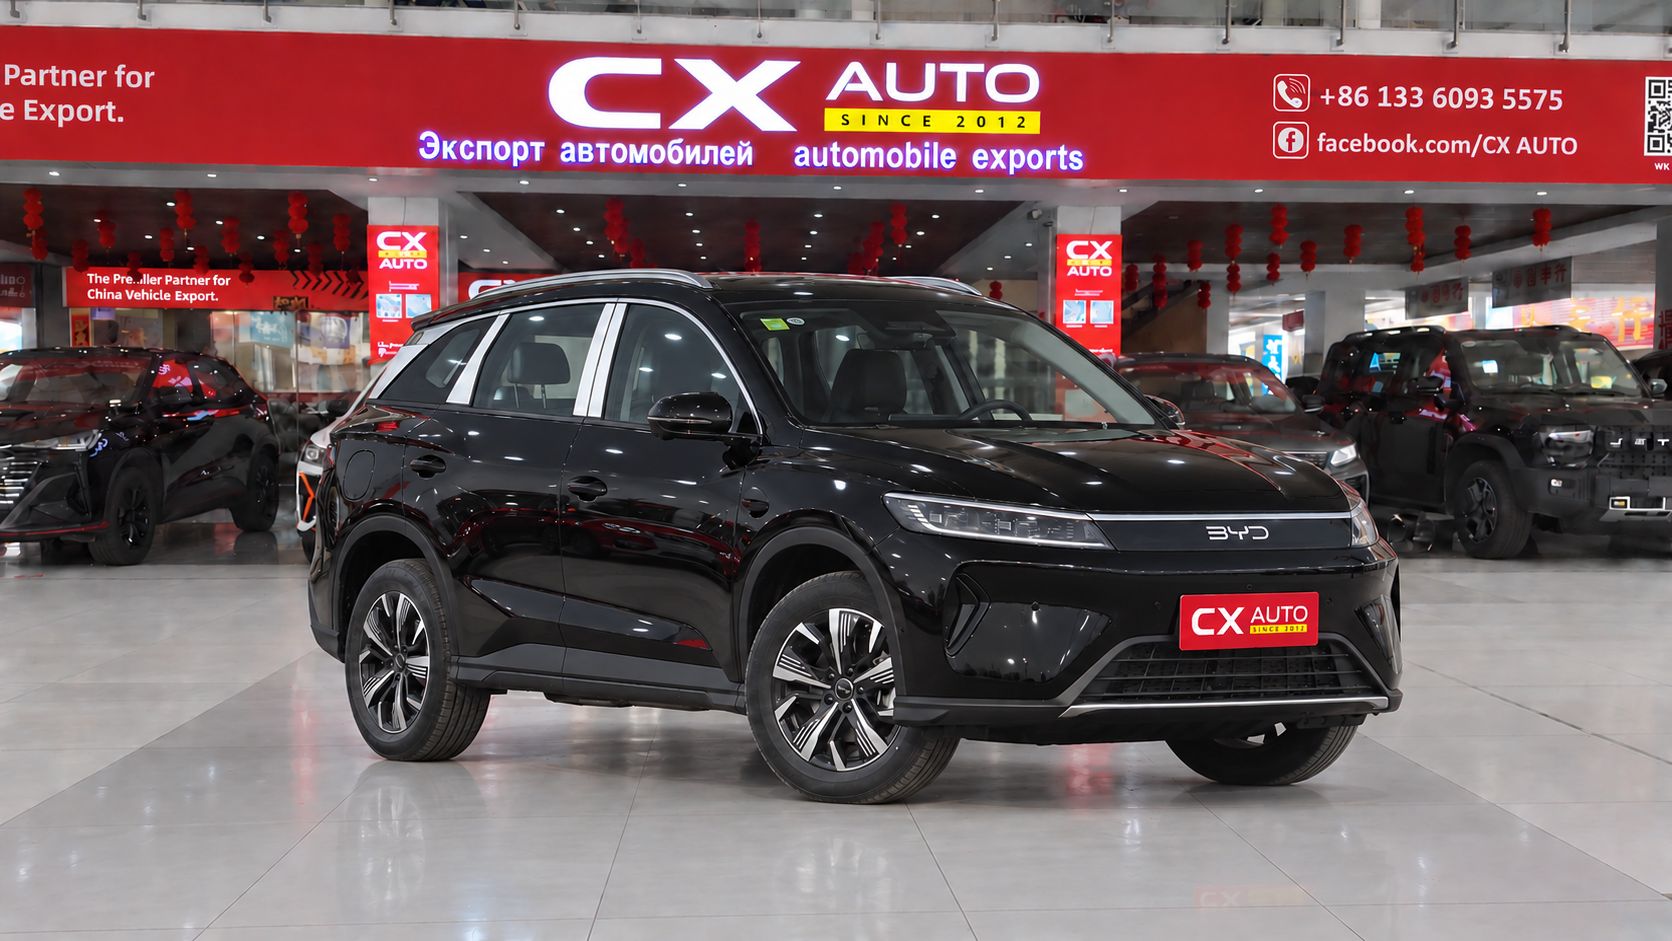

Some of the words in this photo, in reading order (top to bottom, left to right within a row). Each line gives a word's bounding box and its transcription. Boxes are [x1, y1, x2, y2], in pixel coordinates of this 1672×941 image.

[4, 64, 107, 87] Partner
[115, 65, 155, 88] for
[548, 56, 801, 132] CX
[825, 61, 1041, 104] AUTO
[1320, 85, 1369, 108] +86
[1377, 85, 1425, 109] 133
[1432, 87, 1494, 111] 6093
[1502, 88, 1564, 112] 5575
[24, 99, 124, 128] Export.
[841, 113, 932, 127] SINCE
[956, 115, 1027, 129] 2012
[418, 130, 546, 168] Экспорт
[560, 136, 754, 167] автомобилей
[1316, 132, 1510, 158] facebook.com/CX
[1515, 136, 1578, 155] AUTO
[794, 141, 957, 169] automobile
[972, 145, 1084, 175] exports
[1654, 162, 1670, 172] WK
[376, 231, 427, 251] CX
[1066, 240, 1113, 260] CX
[379, 258, 428, 270] AUTO
[1067, 266, 1113, 277] AUTO
[86, 273, 110, 285] The
[165, 275, 211, 288] Partner
[213, 276, 231, 289] for
[87, 288, 123, 300] China
[125, 289, 172, 301] Vehicle
[174, 291, 219, 304] Export.
[1205, 525, 1269, 540] BYD
[1191, 607, 1245, 636] CX
[1250, 605, 1308, 624] AUTO
